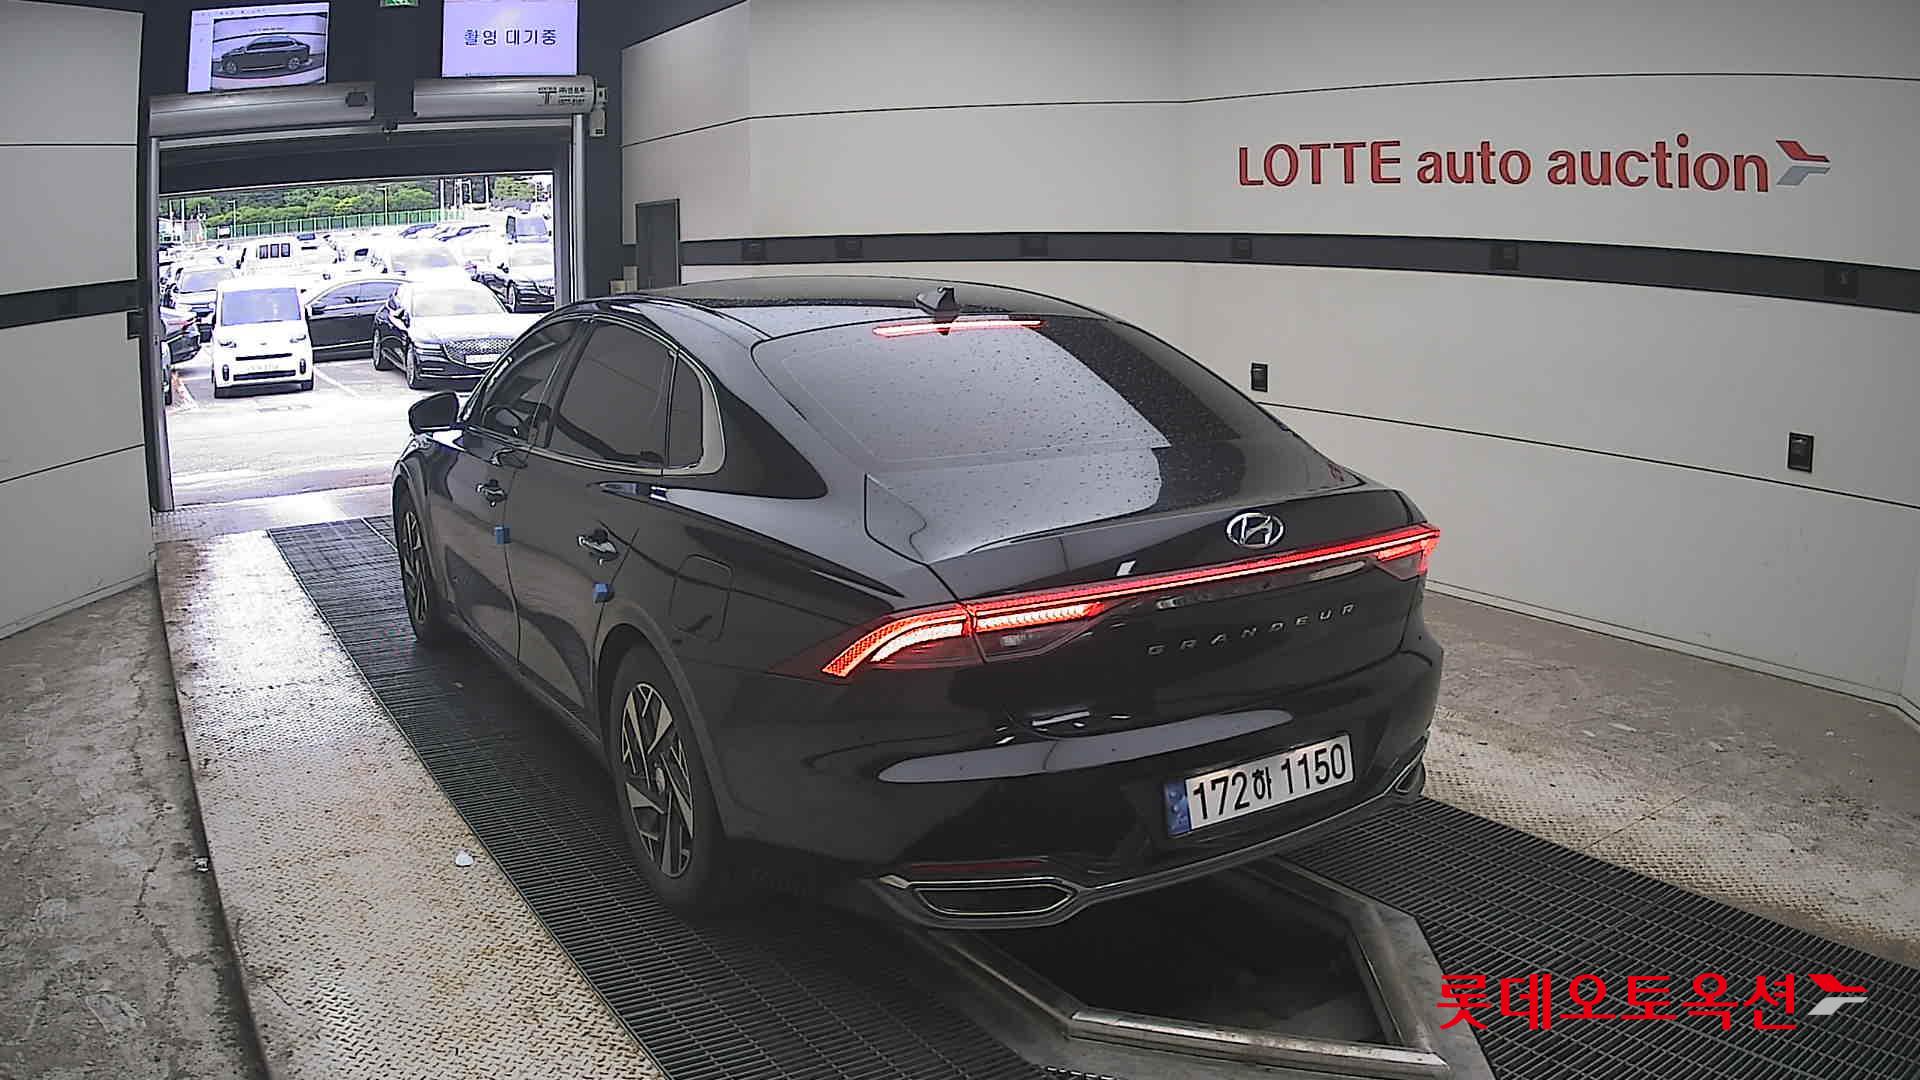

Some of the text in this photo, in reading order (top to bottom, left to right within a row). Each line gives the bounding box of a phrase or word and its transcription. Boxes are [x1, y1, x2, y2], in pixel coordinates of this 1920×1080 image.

[464, 29, 557, 46] 촬영 대기중
[1238, 133, 1769, 193] LOTTE auto auction
[1148, 602, 1355, 655] GRANDEUR
[1193, 743, 1346, 820] 172하 1150
